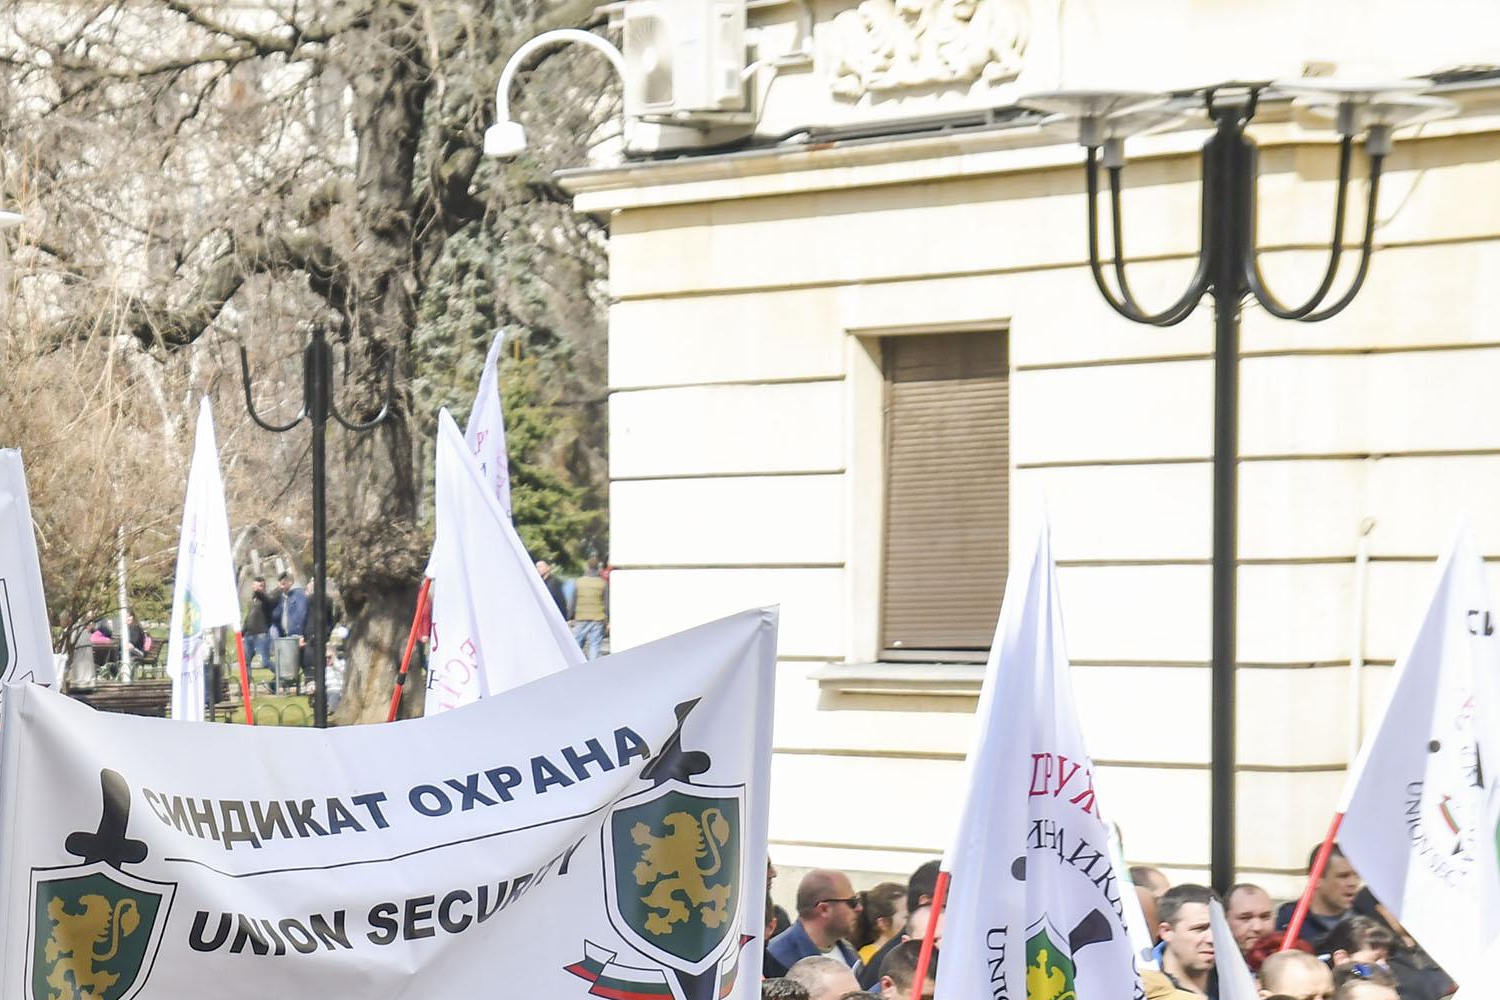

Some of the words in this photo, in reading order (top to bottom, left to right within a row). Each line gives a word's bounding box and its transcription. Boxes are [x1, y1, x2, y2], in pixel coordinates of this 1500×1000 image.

[140, 784, 391, 852] СИНДИКАТ
[408, 723, 653, 820] ОХРАНА
[187, 908, 355, 958] UNION
